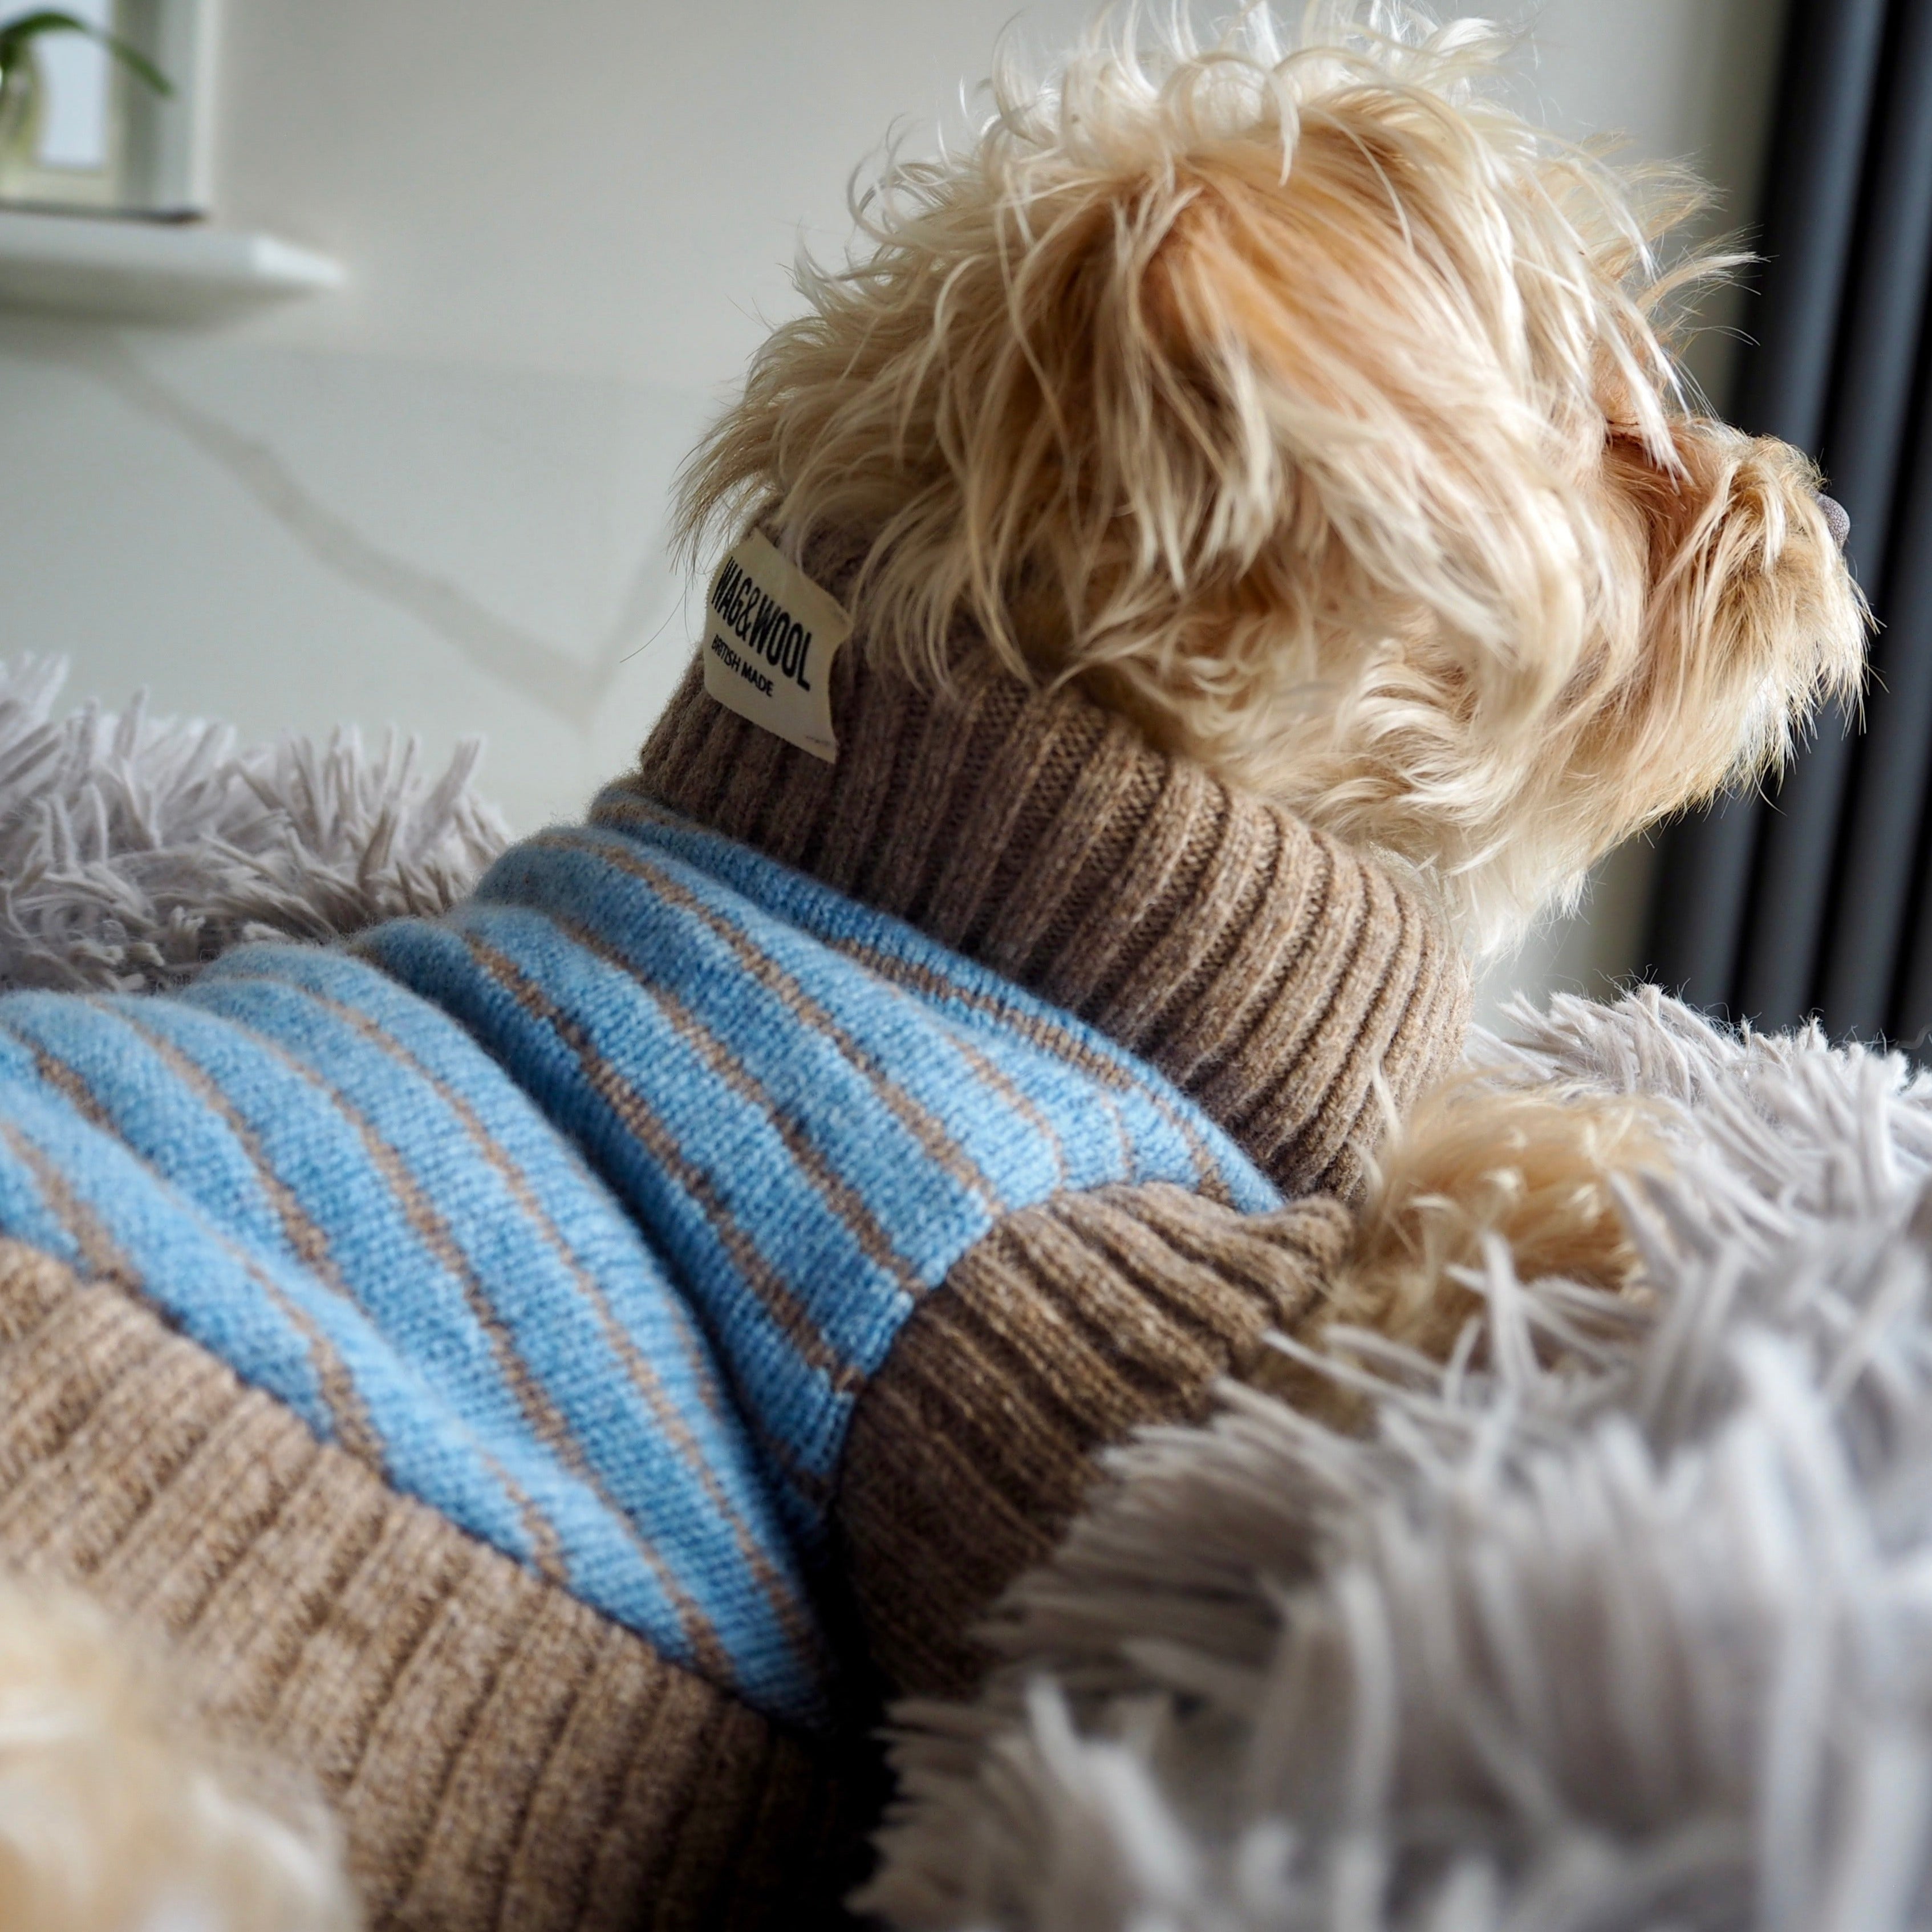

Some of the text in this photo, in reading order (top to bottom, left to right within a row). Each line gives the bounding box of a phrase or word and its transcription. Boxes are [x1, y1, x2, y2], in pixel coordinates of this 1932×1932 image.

[711, 556, 812, 692] WAG&WOOL
[711, 634, 773, 697] BRITISH MADE
